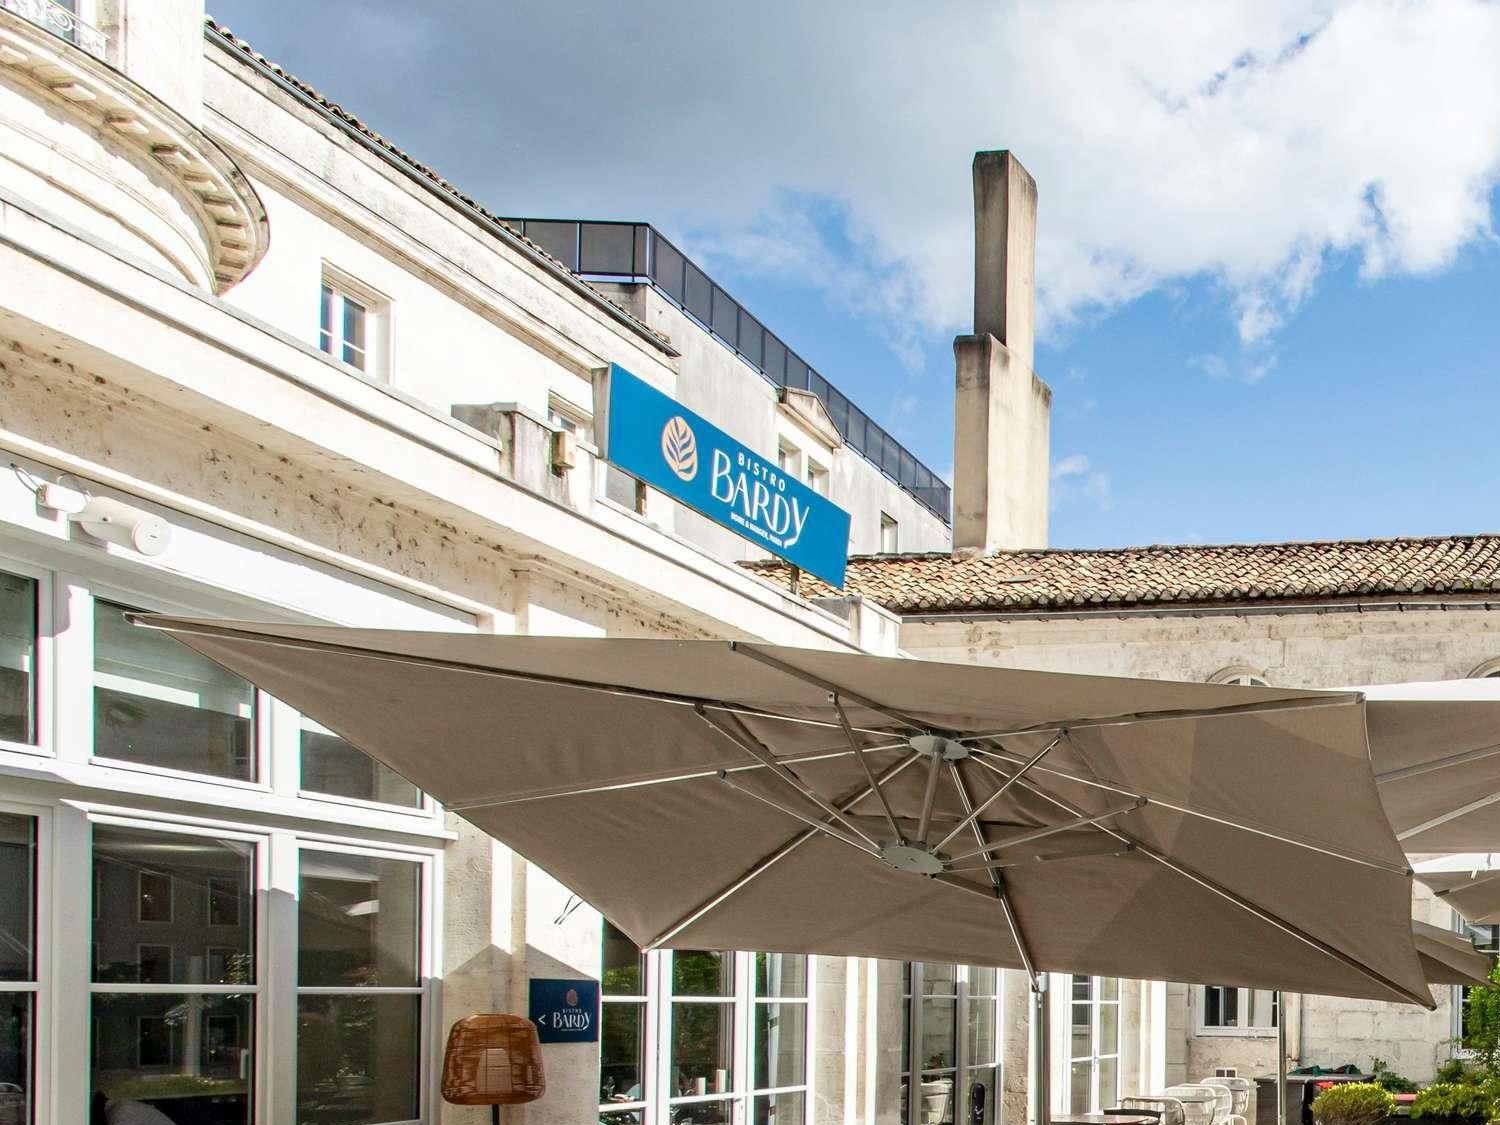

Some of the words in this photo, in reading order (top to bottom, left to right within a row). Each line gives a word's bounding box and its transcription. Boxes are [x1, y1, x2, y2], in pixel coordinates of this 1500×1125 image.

[738, 451, 786, 491] BISTRO
[712, 448, 810, 549] BARDY
[553, 1011, 592, 1030] BARDY
